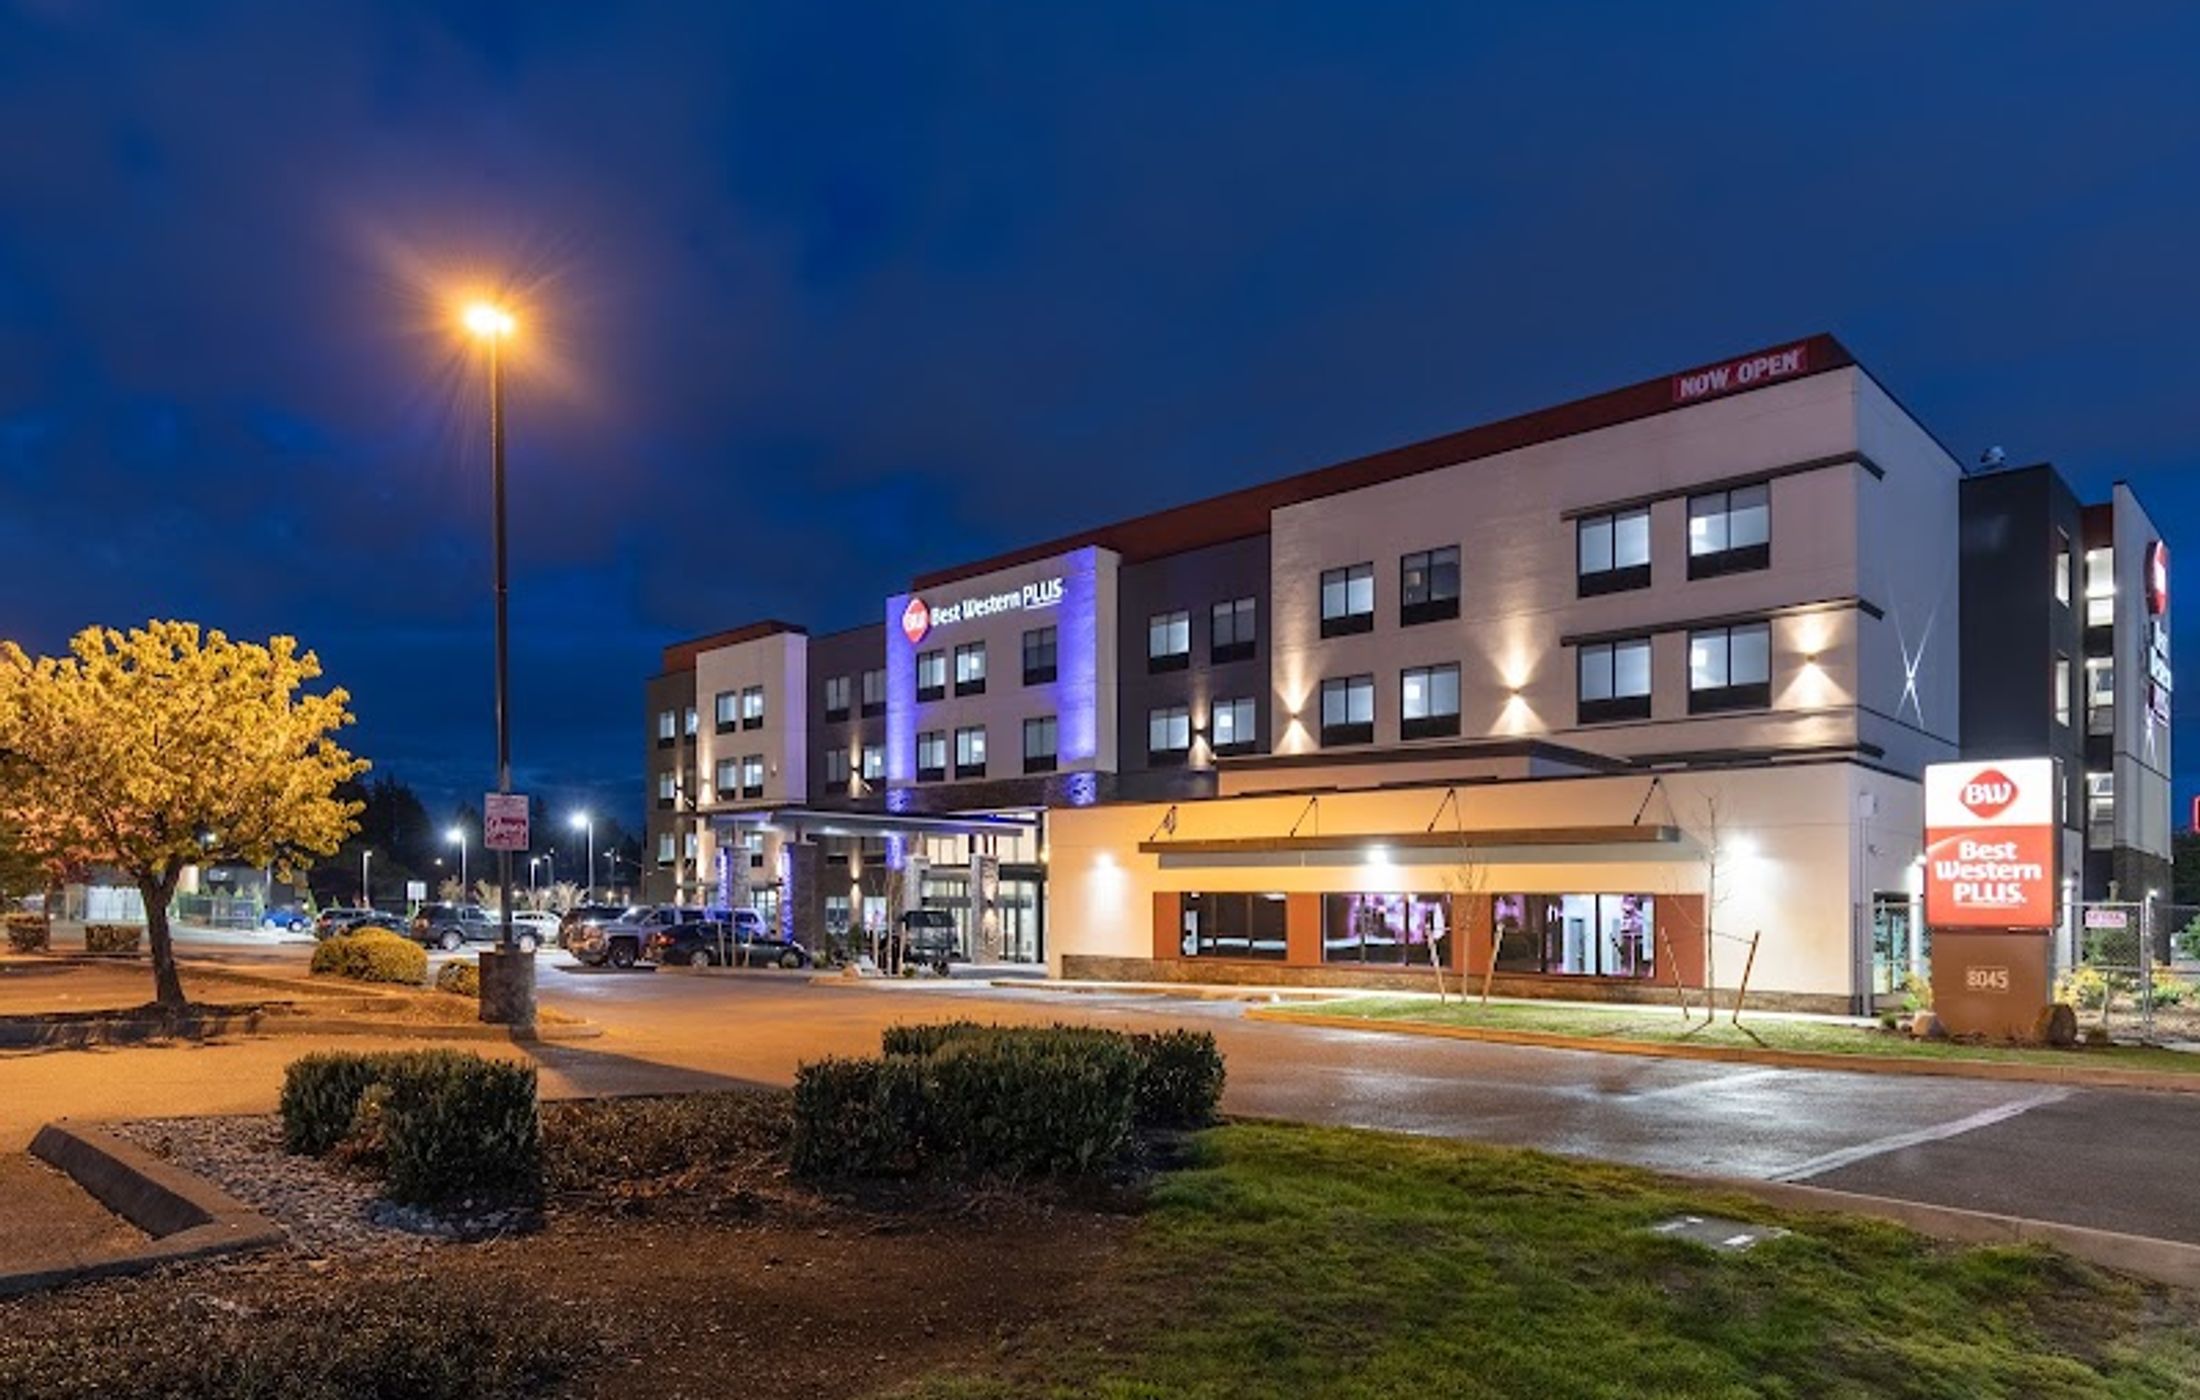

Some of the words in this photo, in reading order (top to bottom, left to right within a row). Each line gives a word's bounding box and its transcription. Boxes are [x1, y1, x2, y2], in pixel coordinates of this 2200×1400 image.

[1680, 367, 1730, 398] NOW
[1737, 348, 1800, 384] OPEN
[930, 604, 961, 627] Best
[962, 589, 1021, 621] Western
[1023, 577, 1063, 604] PLUS
[1965, 781, 2013, 806] BW
[1959, 838, 2018, 861] Best
[1935, 860, 2042, 881] Western
[1966, 970, 2009, 989] 8045
